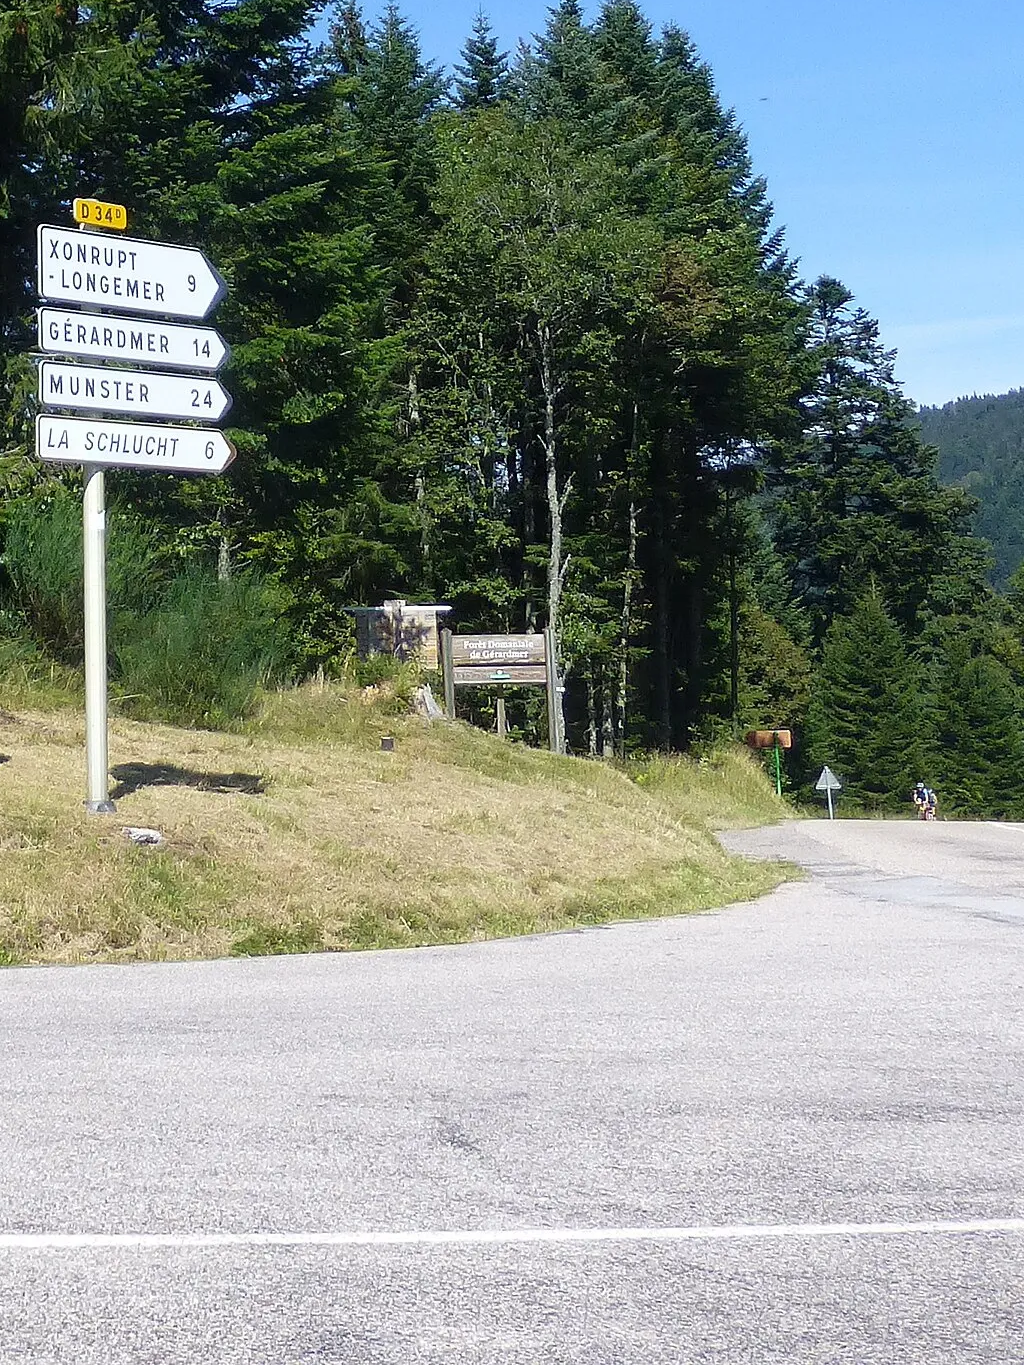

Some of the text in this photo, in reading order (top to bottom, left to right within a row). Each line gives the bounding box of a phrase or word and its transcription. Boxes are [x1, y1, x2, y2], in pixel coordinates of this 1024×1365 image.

[81, 203, 90, 219] D
[49, 238, 138, 271] XONRUPT
[187, 274, 196, 293] 9
[49, 318, 211, 358] GÉRARDMER 14
[49, 374, 212, 409] MUNSTER 24
[47, 427, 215, 460] LA SCHLUCHT 6
[469, 649, 529, 659] de Gérardmer
[488, 640, 534, 649] Domaniale
